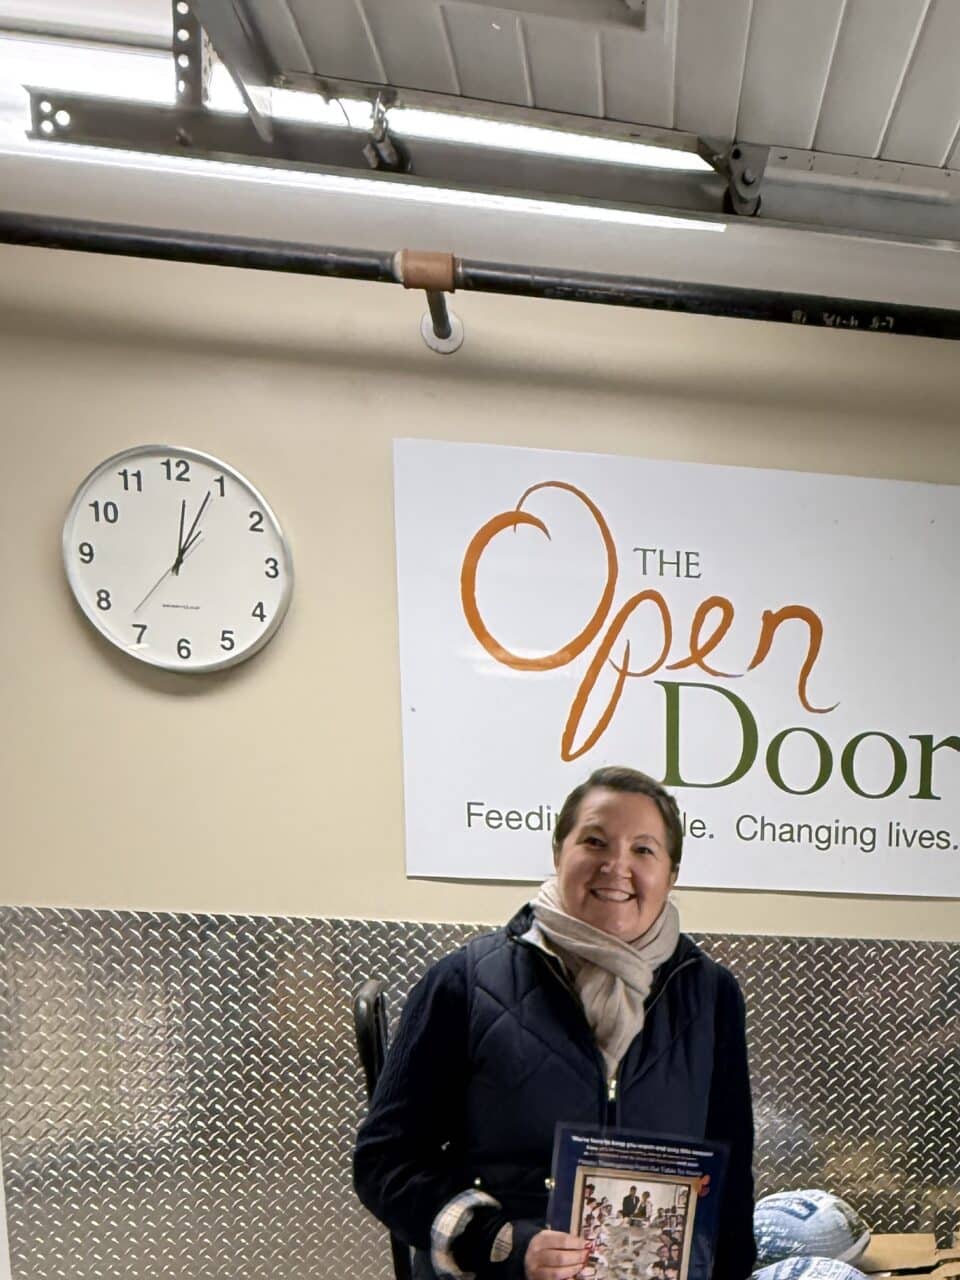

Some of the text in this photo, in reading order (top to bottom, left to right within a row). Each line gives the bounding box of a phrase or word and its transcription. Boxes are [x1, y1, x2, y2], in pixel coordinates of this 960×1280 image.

[118, 469, 142, 492] 11
[160, 459, 190, 482] 12
[214, 476, 225, 497] 1
[89, 500, 119, 524] 10
[249, 511, 264, 532] 2
[79, 542, 94, 564] 9
[633, 547, 702, 579] THE
[264, 557, 279, 579] 3
[96, 589, 111, 610] 8
[251, 601, 266, 622] 4
[461, 481, 840, 762] Open
[132, 623, 147, 644] 7
[220, 630, 235, 651] 5
[177, 638, 191, 659] 6
[466, 802, 557, 834] Feedi
[735, 814, 877, 852] Changing
[888, 822, 959, 851] lives.
